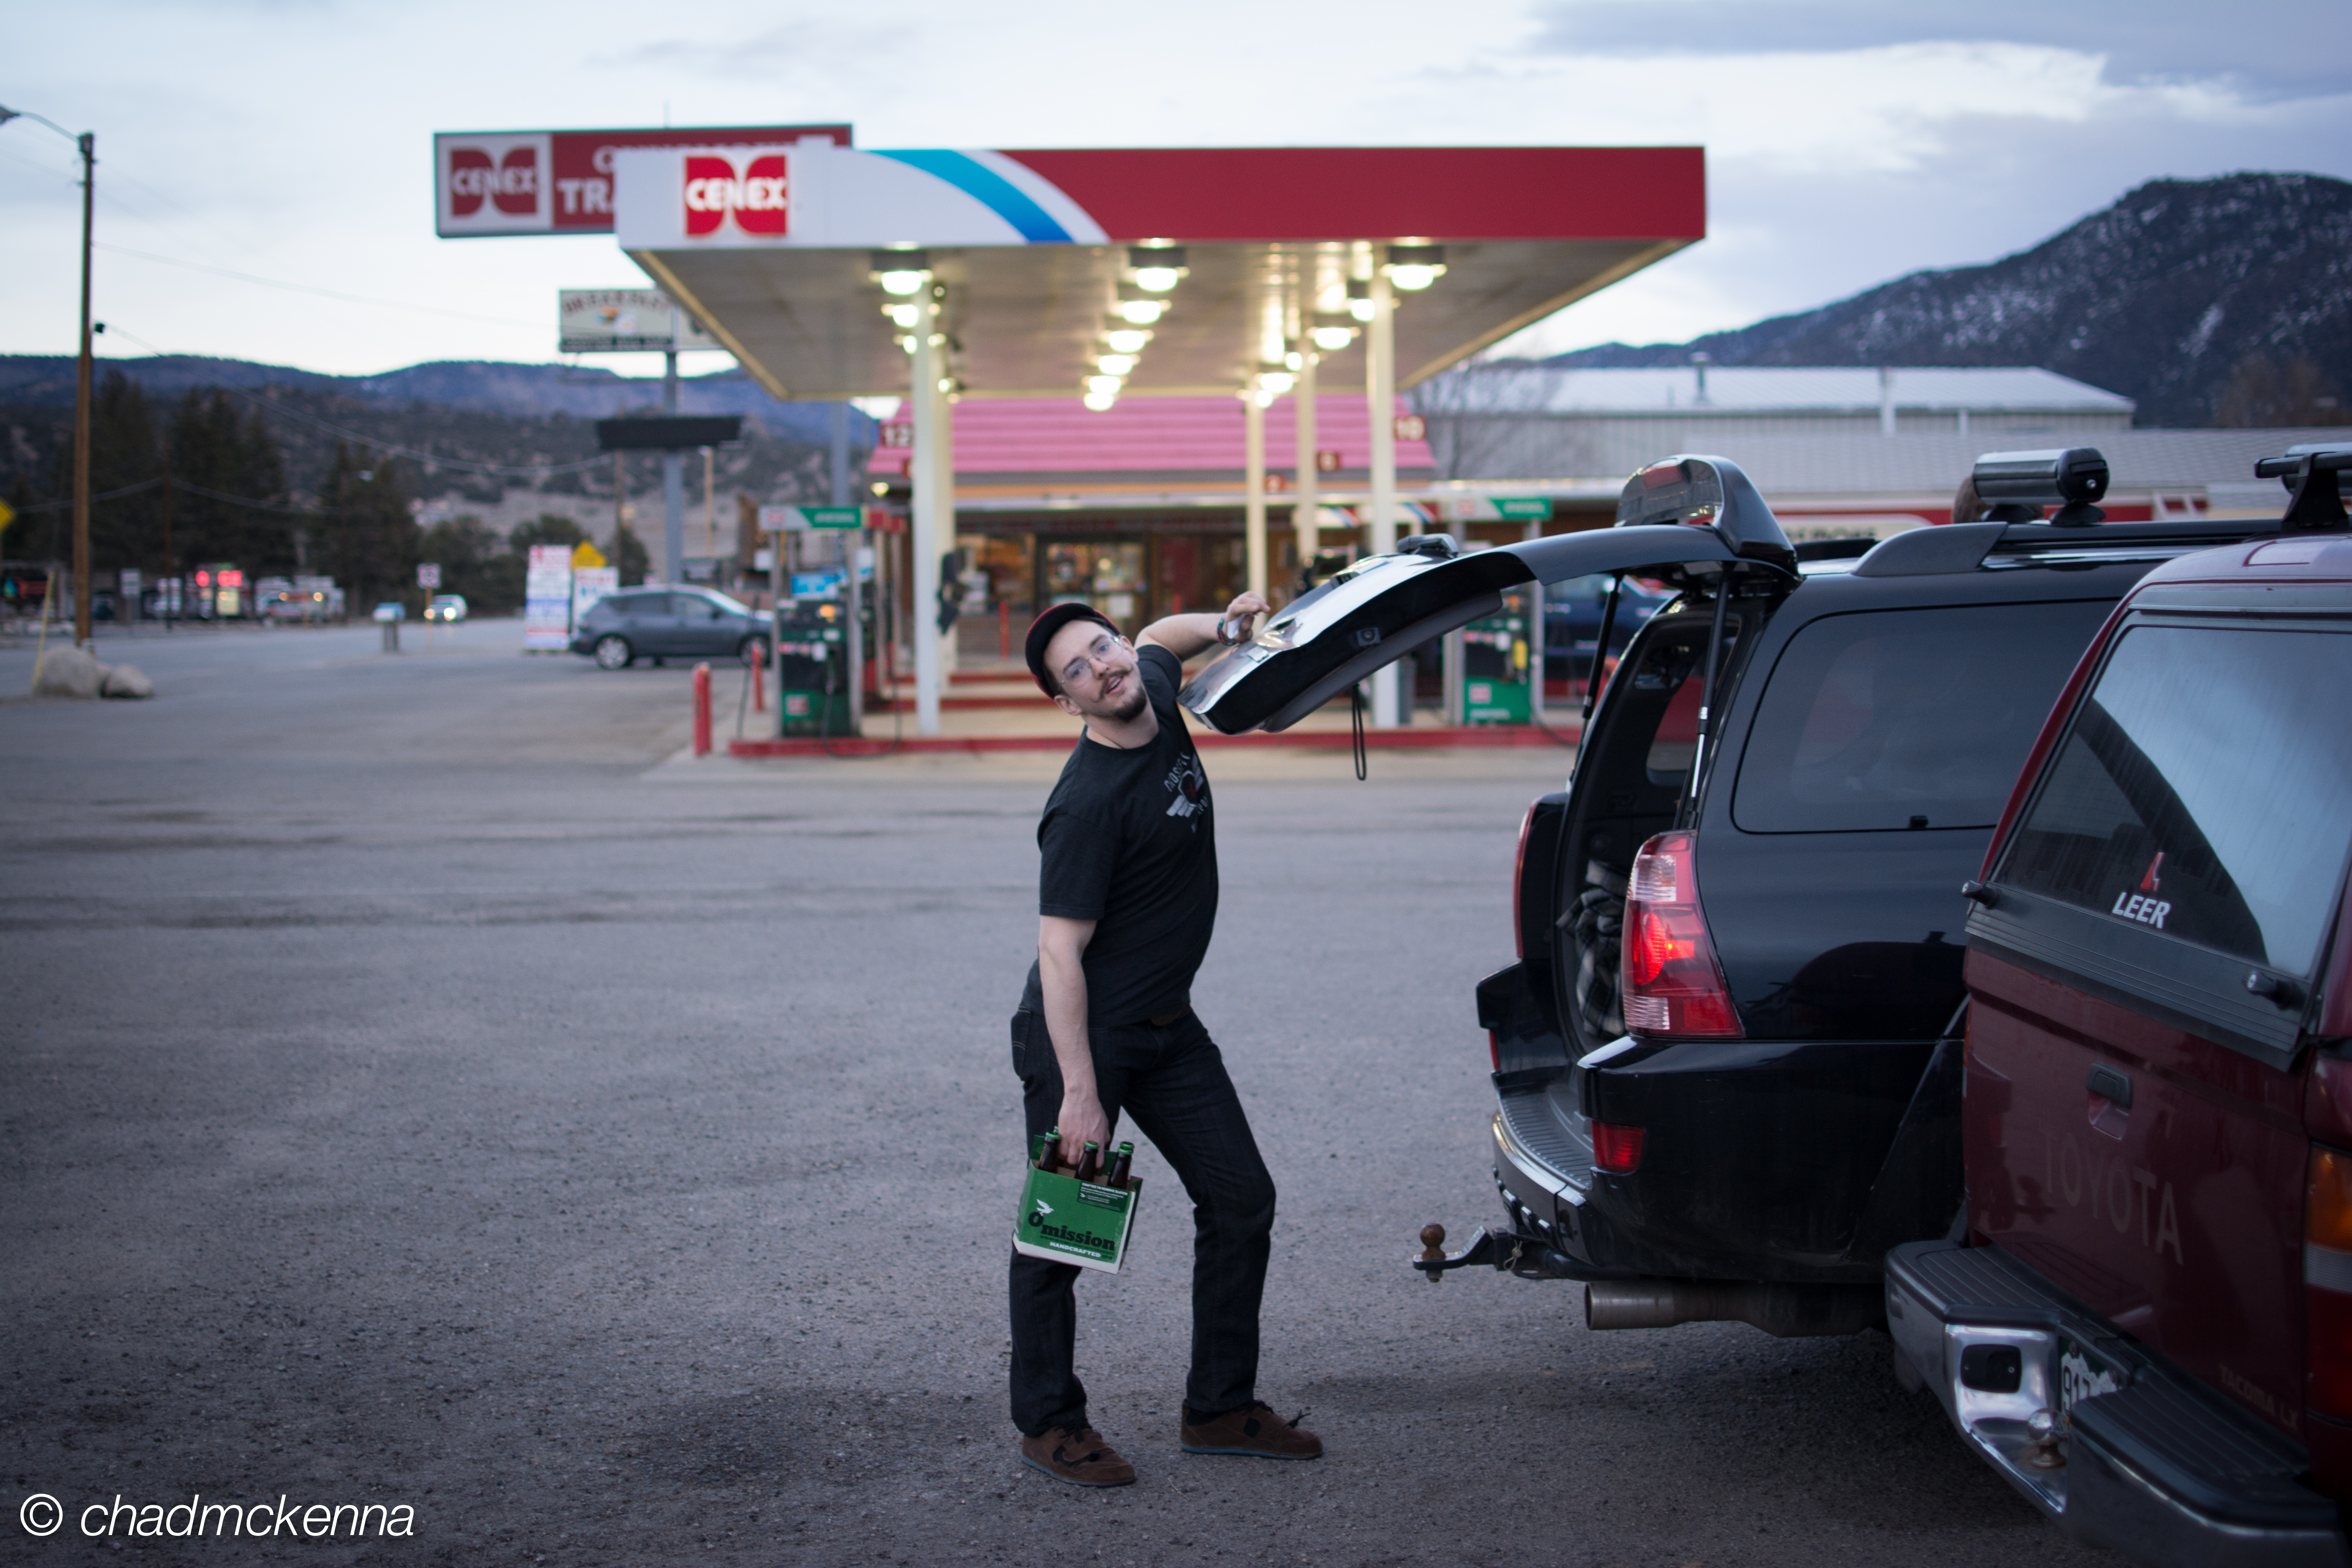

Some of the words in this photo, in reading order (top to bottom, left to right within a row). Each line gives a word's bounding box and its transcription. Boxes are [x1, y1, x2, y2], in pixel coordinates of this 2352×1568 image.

[452, 167, 536, 195] CENEX
[557, 177, 614, 214] TR
[685, 177, 787, 211] CENEX
[2112, 892, 2171, 929] LEER
[2040, 1120, 2184, 1266] TOYOTA
[1028, 1211, 1115, 1250] Omission
[1050, 1241, 1101, 1258] HANDCRAFTED
